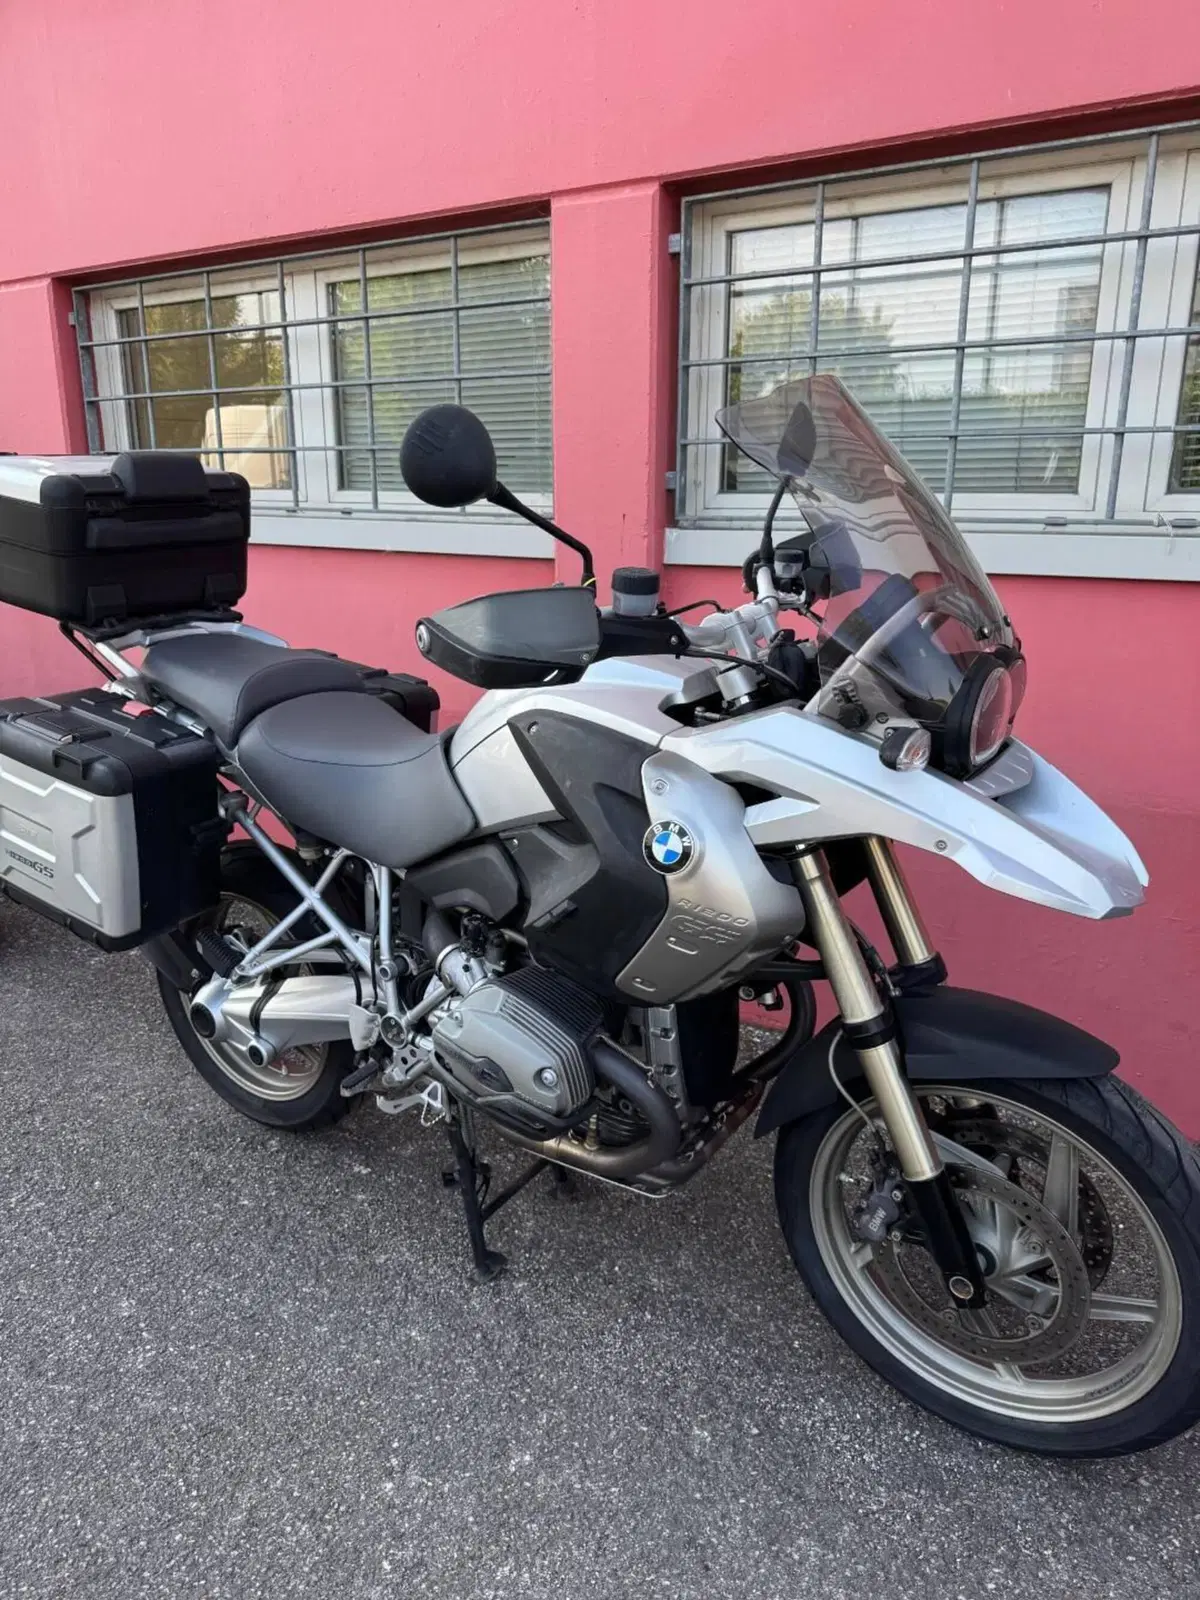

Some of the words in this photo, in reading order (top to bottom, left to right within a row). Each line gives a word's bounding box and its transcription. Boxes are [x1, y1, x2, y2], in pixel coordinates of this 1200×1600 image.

[652, 823, 691, 847] BMW
[677, 899, 749, 927] R1200
[869, 1207, 887, 1232] BMW
